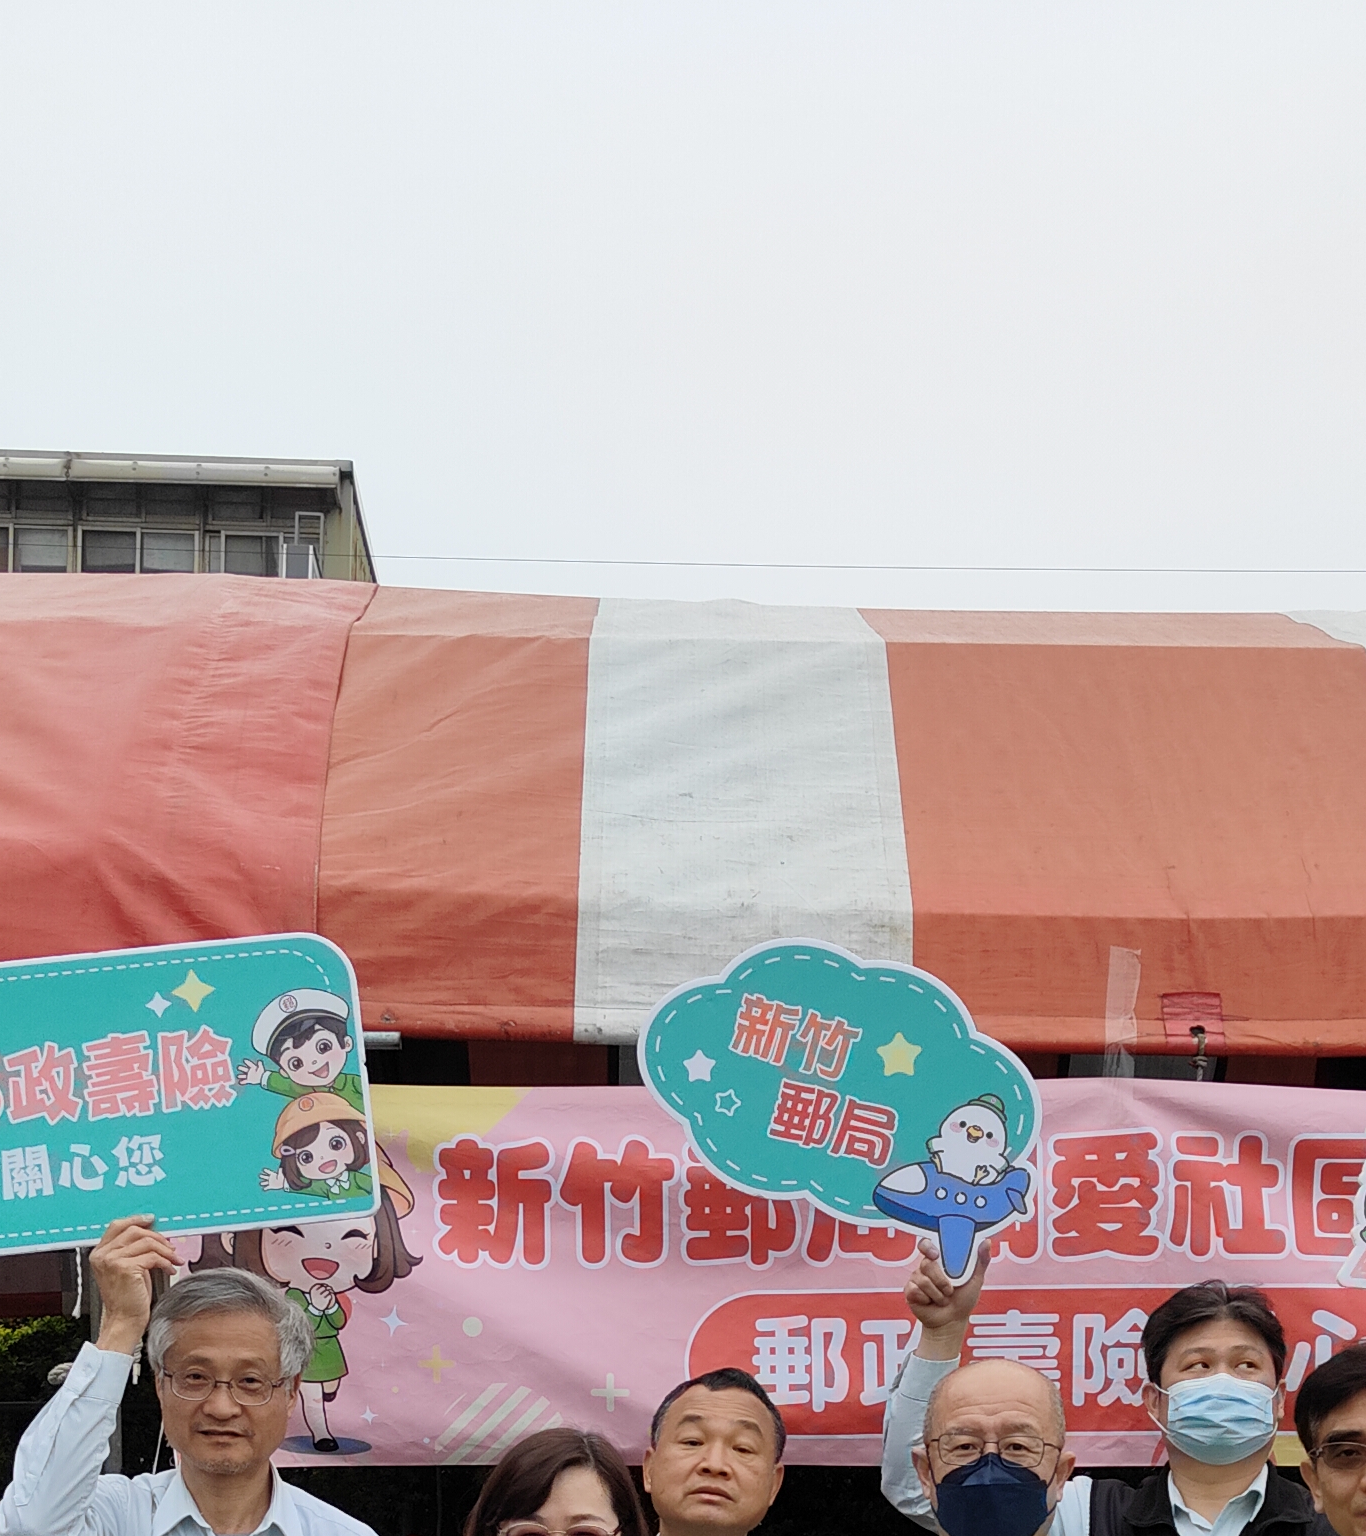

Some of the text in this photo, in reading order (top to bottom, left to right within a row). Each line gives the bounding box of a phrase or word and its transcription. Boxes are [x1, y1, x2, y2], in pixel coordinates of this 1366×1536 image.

[730, 992, 862, 1081] 新竹
[2, 1134, 167, 1200] 關心您
[769, 1078, 898, 1169] 郵局
